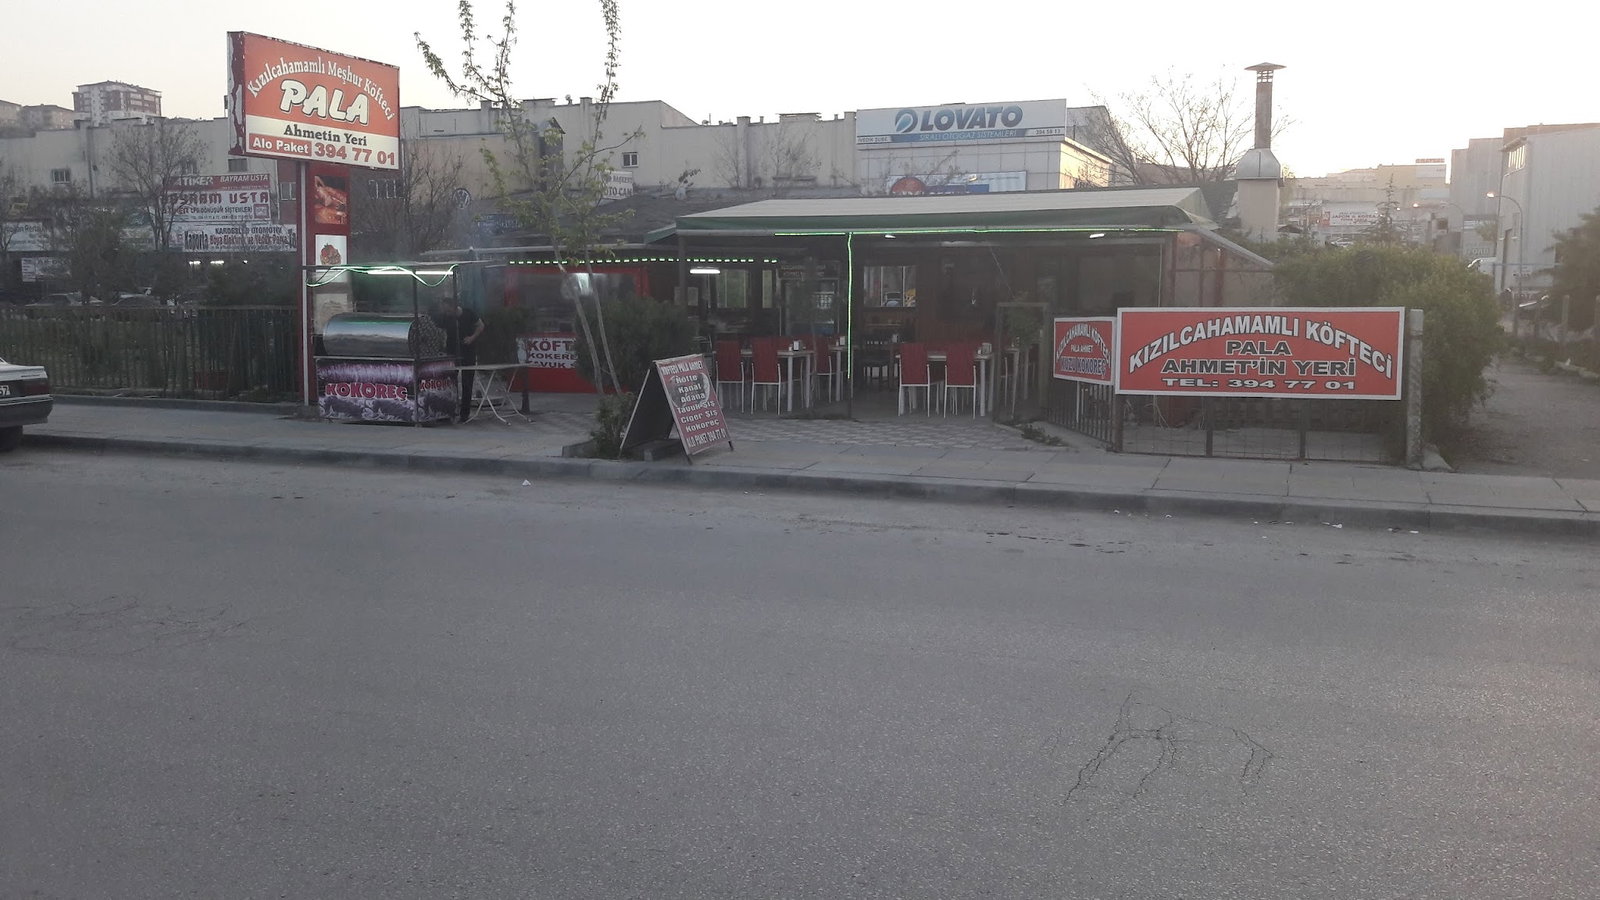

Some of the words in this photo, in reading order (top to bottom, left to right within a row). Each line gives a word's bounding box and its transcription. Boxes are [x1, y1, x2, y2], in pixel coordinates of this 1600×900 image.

[248, 57, 325, 98] Kızılcahamamlı
[328, 61, 363, 88] Meşhur
[364, 77, 396, 120] Köfteci
[279, 79, 369, 126] PALA
[920, 104, 1024, 132] LOVATO
[283, 124, 341, 143] Ahmetin
[343, 133, 367, 146] Yeri
[253, 137, 272, 150] Alo
[276, 140, 309, 154] Paket
[314, 142, 347, 160] 394
[351, 147, 373, 163] 77
[376, 150, 395, 166] 01
[229, 192, 269, 204] USTA
[1128, 315, 1299, 374] KIZILCAHAMAMLI
[1305, 320, 1392, 379] KÖFTECİ
[1225, 339, 1293, 356] PALA
[1293, 357, 1356, 376] YERİ
[325, 382, 408, 402] KOKOREÇ
[1161, 378, 1219, 387] TEL:
[1228, 379, 1276, 389] 394
[1284, 380, 1316, 389] 77
[1324, 381, 1355, 390] 01
